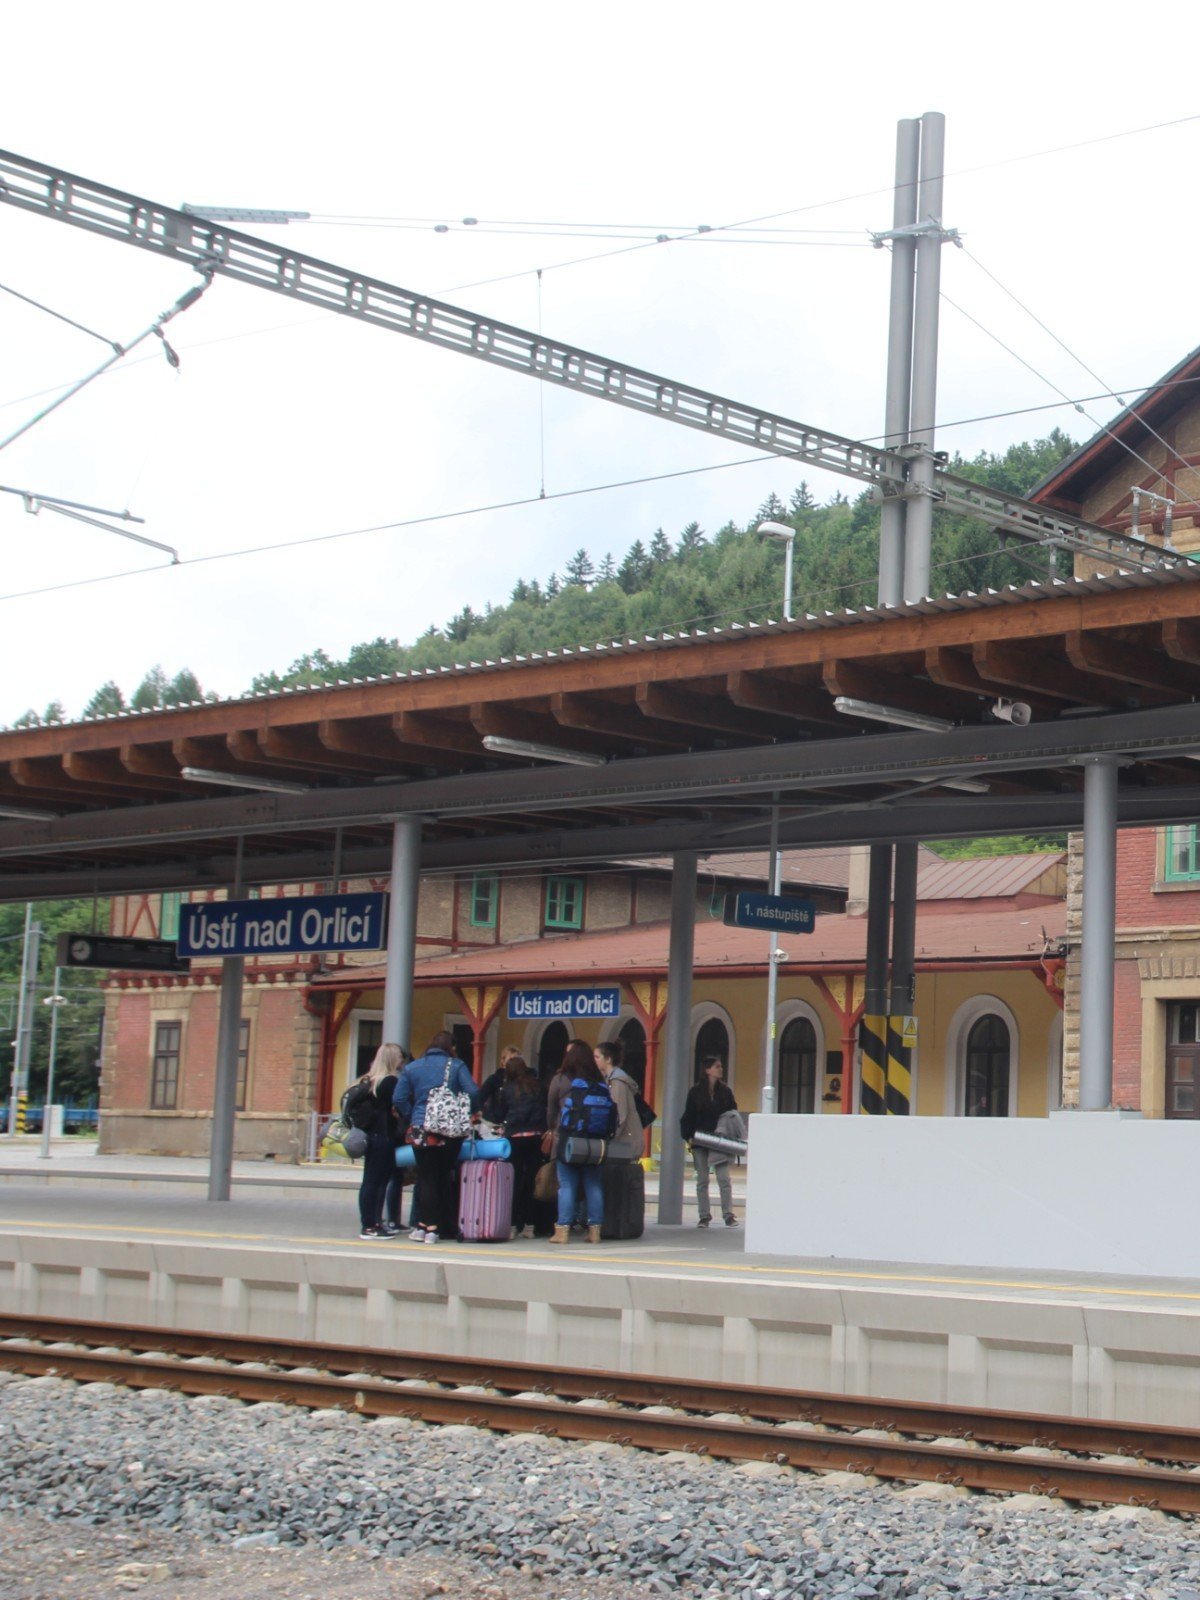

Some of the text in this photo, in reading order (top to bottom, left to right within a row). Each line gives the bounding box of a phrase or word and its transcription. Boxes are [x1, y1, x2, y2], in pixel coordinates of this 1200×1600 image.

[744, 903, 809, 923] 1. nástupiště
[189, 905, 372, 949] Ústí nad Orlicí
[514, 992, 614, 1015] Ústí nad Orlicí
